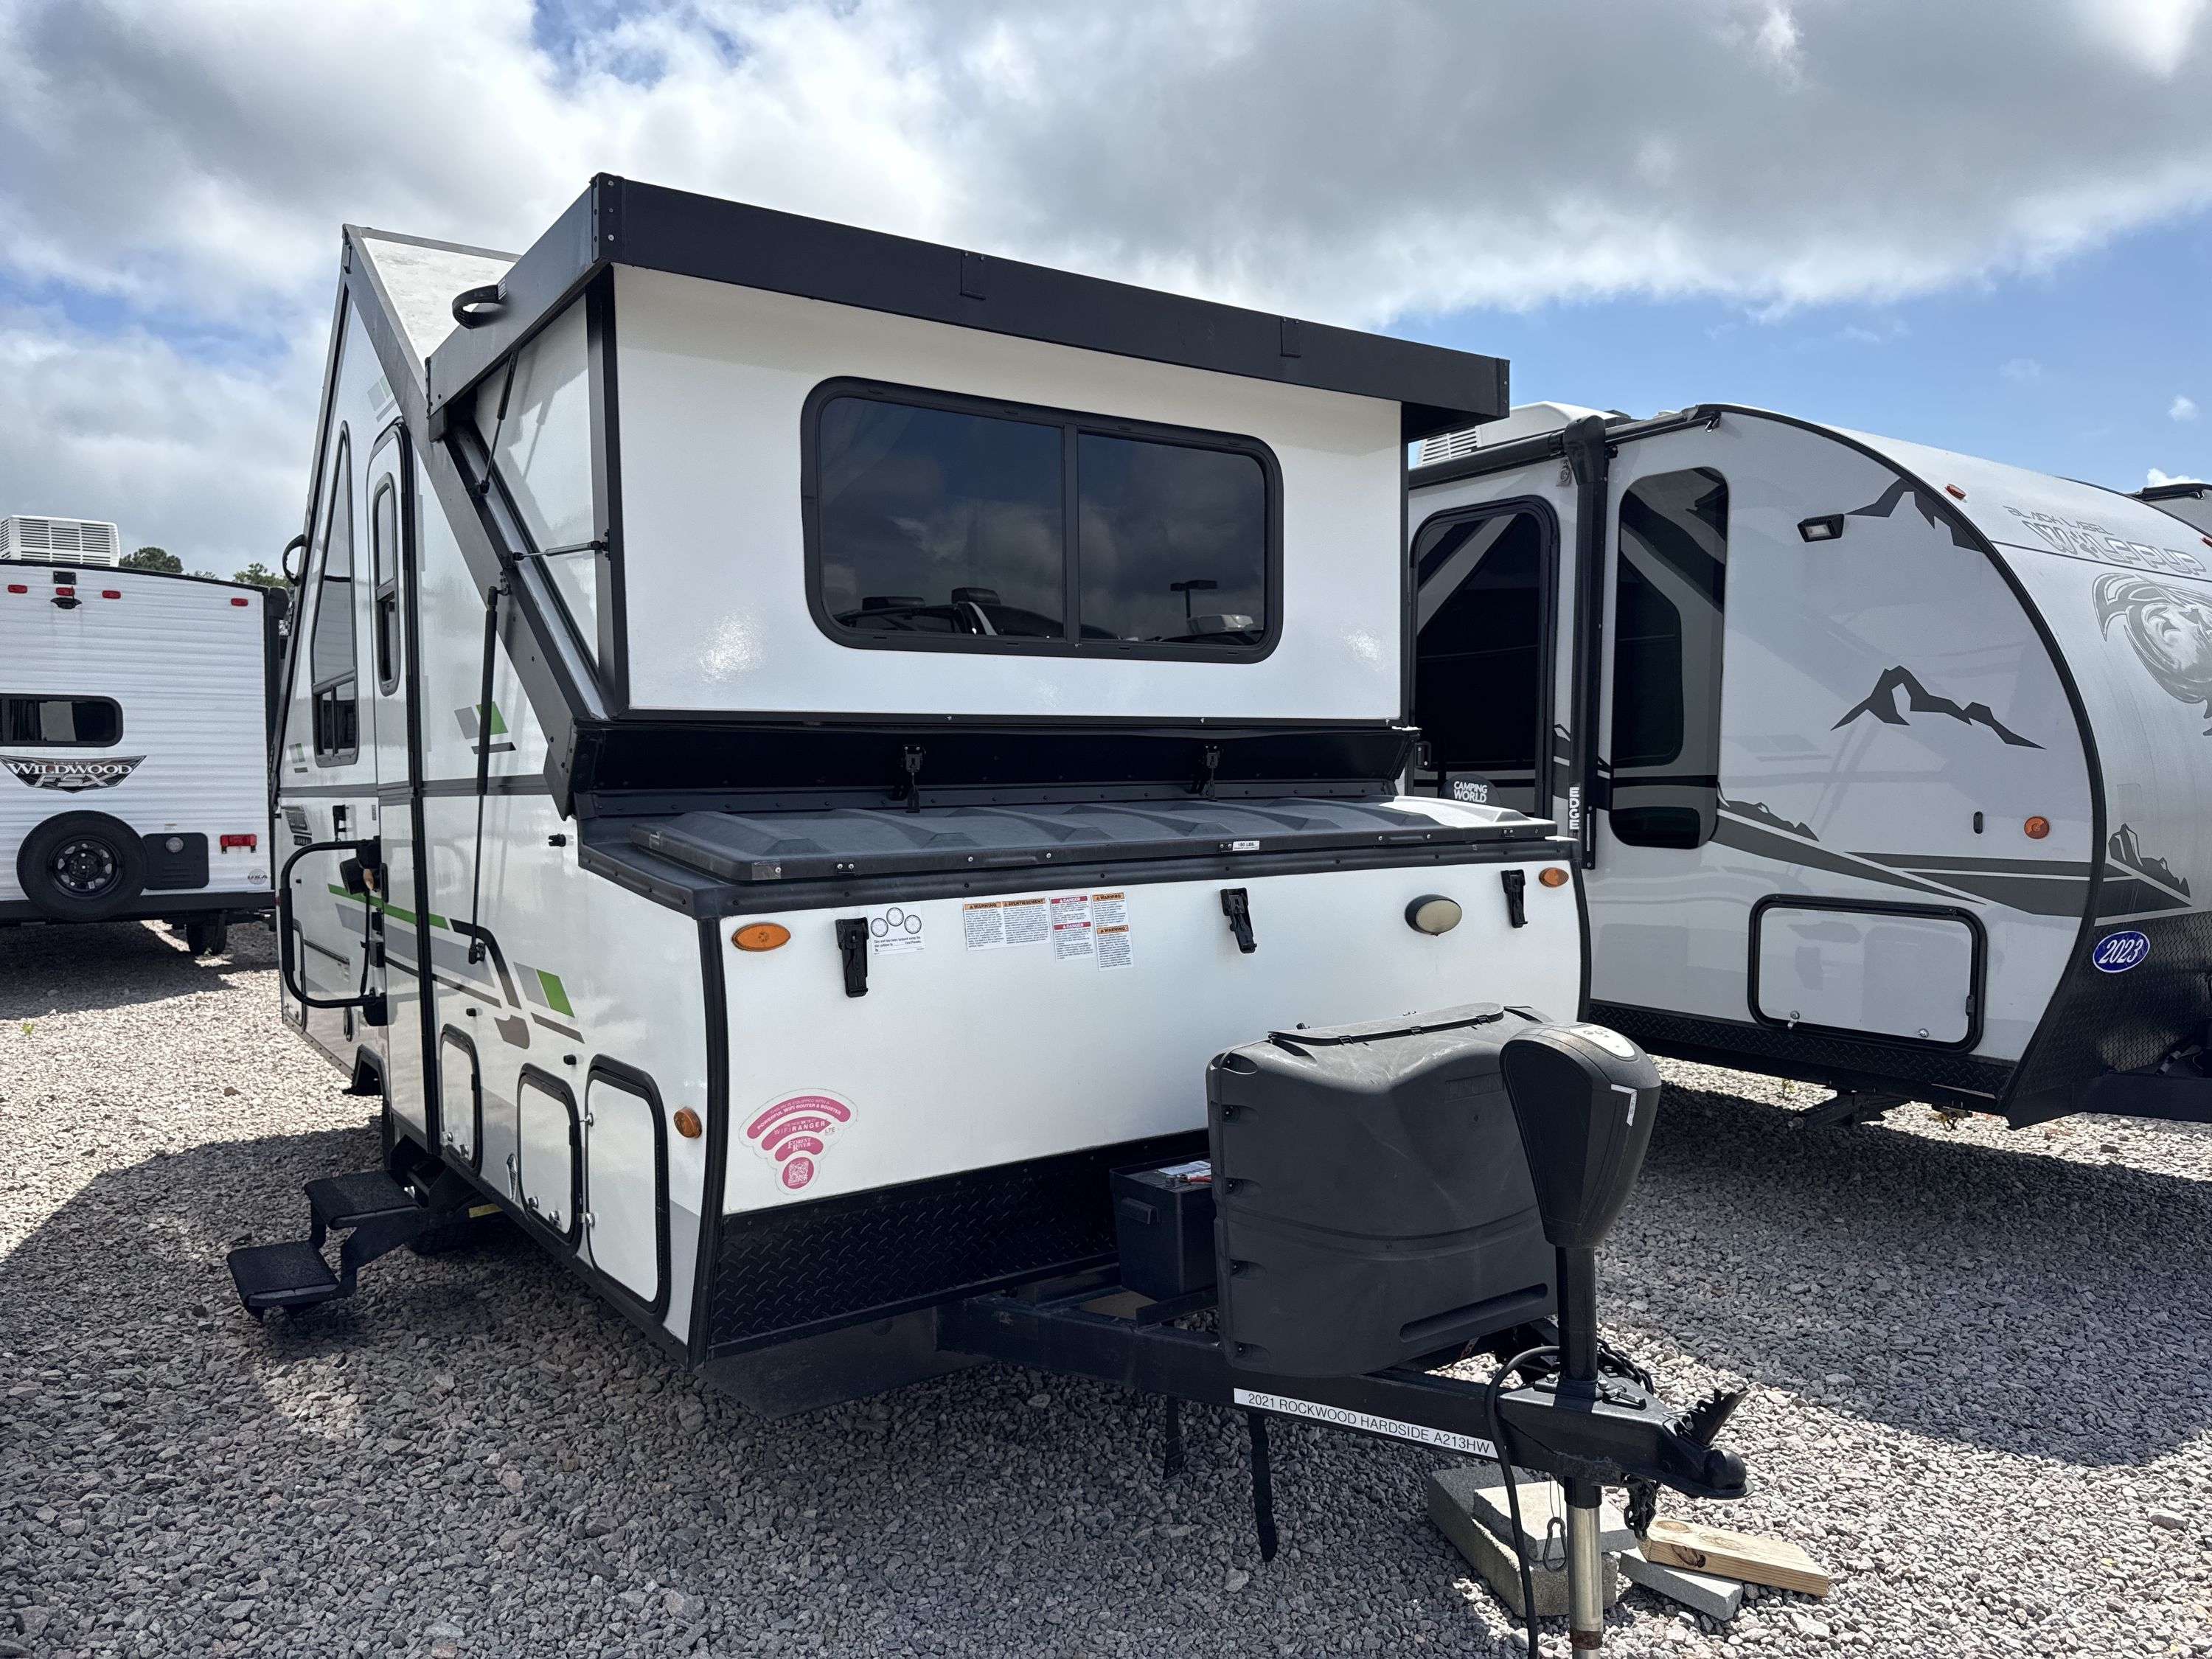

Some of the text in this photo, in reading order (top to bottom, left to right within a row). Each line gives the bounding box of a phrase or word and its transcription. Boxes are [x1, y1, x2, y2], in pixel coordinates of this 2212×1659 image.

[2003, 505, 2115, 535] BLACK LABEL
[7, 763, 133, 774] WILDWOOD
[35, 774, 116, 787] FSX
[1454, 781, 1487, 793] CAMPING
[1454, 790, 1486, 803] WORLD
[1569, 787, 1579, 830] EDGE
[2098, 939, 2143, 964] 2023
[757, 1111, 782, 1130] POWERFUL
[821, 1104, 841, 1115] BOOSTER
[787, 1138, 811, 1149] FOREST
[793, 1143, 811, 1151] RIVER
[1248, 1393, 1490, 1454] 2021 ROCKWOOD HARDSIDE A213HW
